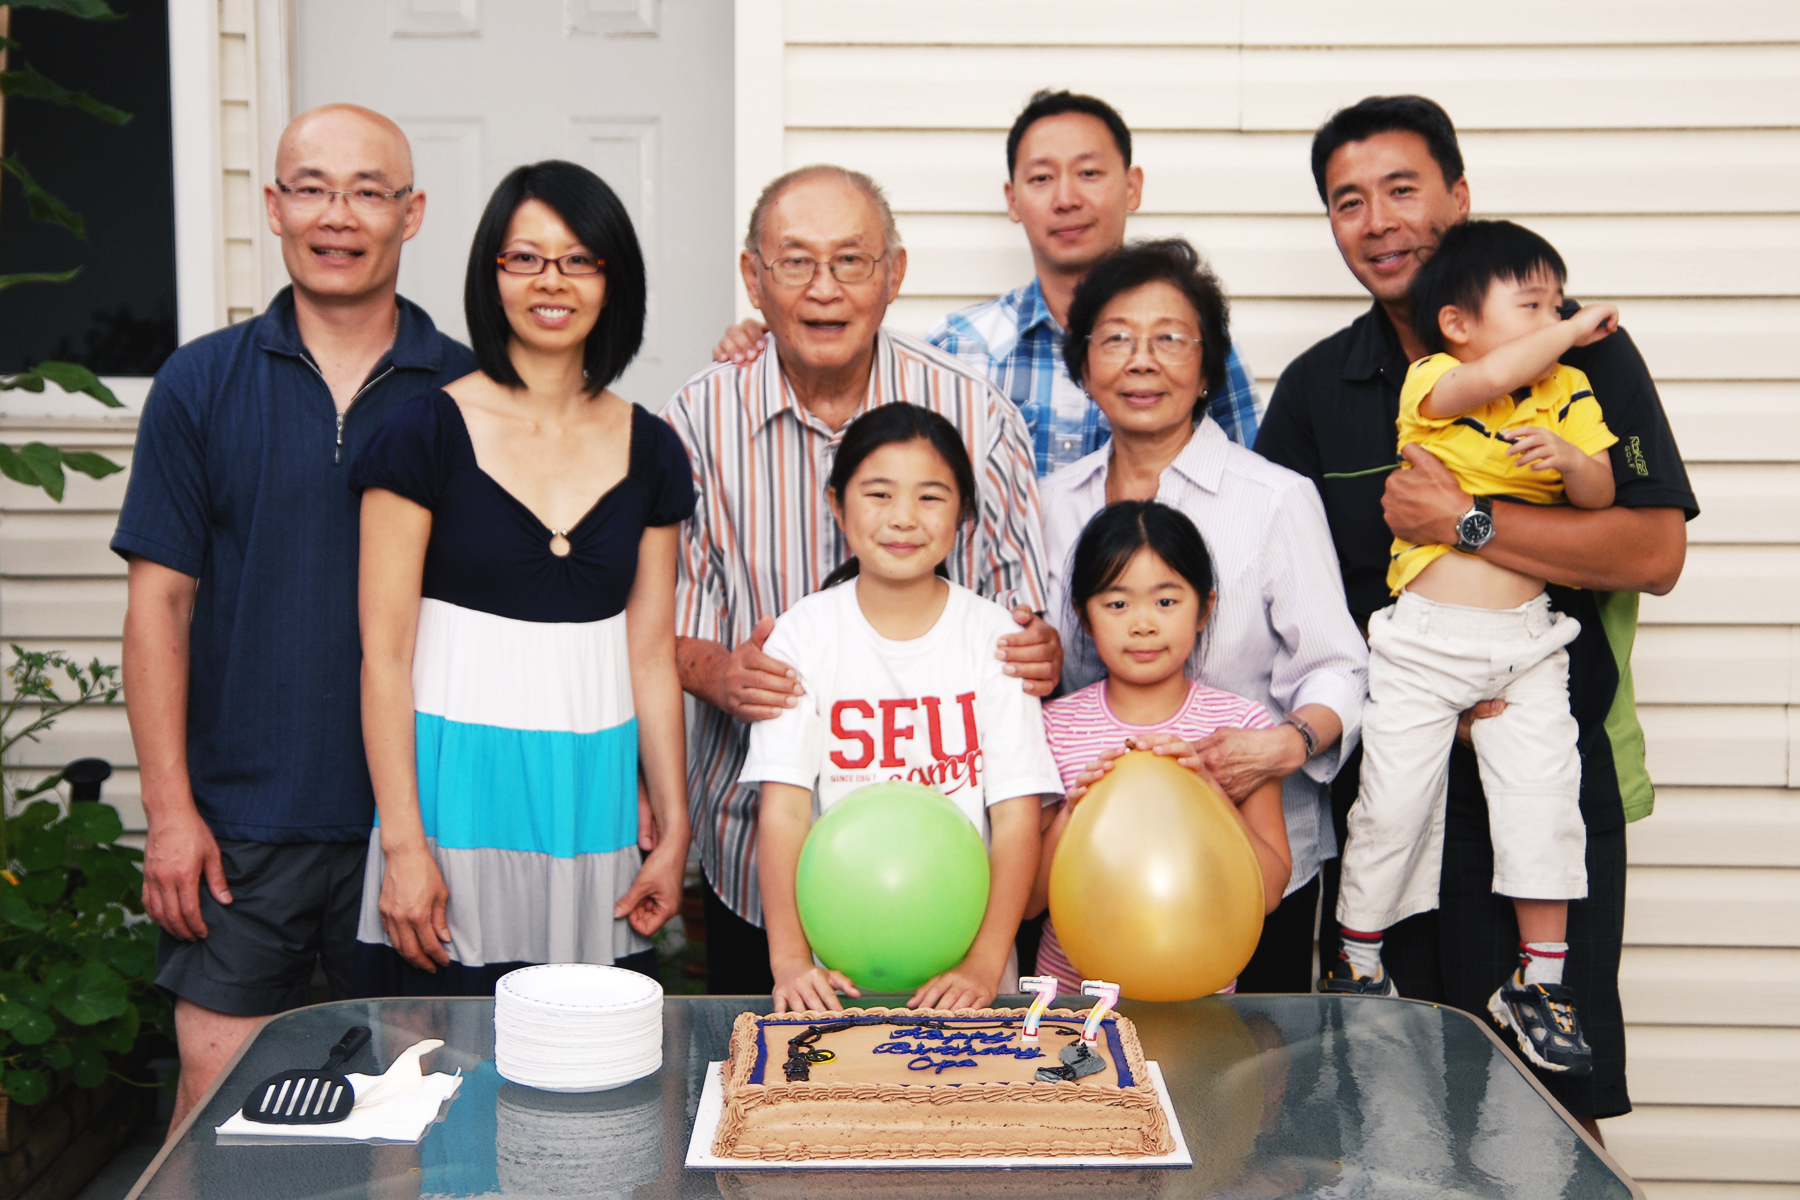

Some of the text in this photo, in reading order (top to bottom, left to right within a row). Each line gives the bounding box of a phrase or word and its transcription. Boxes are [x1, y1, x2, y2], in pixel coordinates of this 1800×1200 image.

[1624, 445, 1636, 468] GOLF
[829, 691, 979, 769] SFU
[830, 773, 877, 782] SINCE 1967
[889, 1026, 1017, 1045] Happy
[872, 1041, 1047, 1060] Birthday
[907, 1055, 978, 1075] Opa
